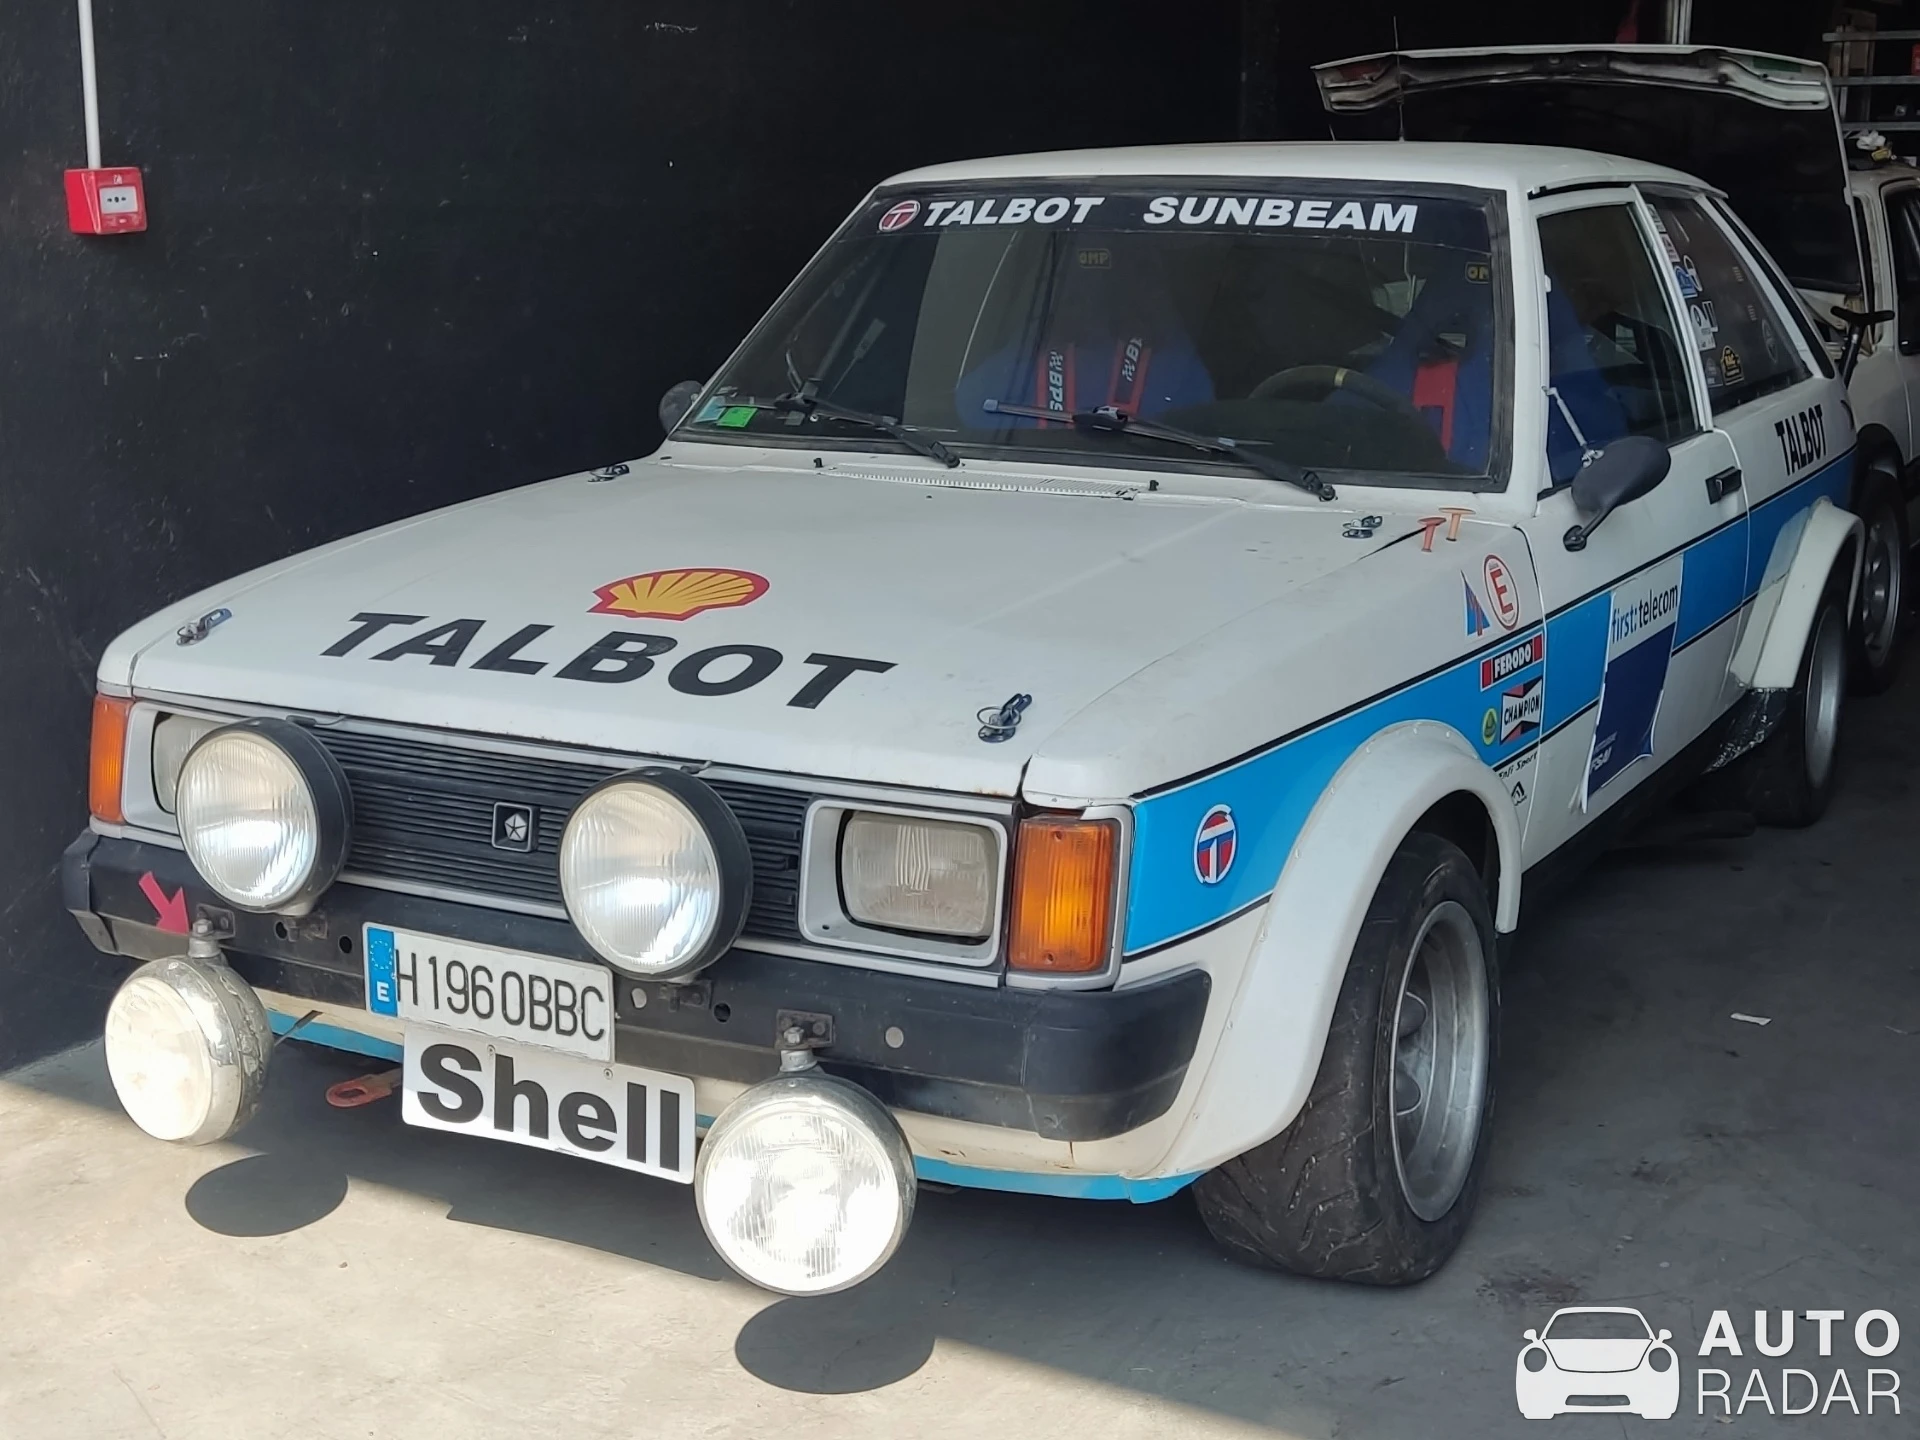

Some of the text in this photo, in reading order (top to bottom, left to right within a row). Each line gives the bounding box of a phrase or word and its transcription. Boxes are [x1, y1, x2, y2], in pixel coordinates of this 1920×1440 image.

[924, 197, 1105, 227] TALBOT
[1143, 196, 1418, 233] SUNBEAM
[1774, 404, 1826, 476] TALBOT
[319, 612, 899, 710] TALBOT
[1494, 642, 1532, 679] FERODO
[1504, 693, 1540, 726] CHAMPION
[376, 980, 390, 1003] E
[416, 1043, 681, 1173] Shell
